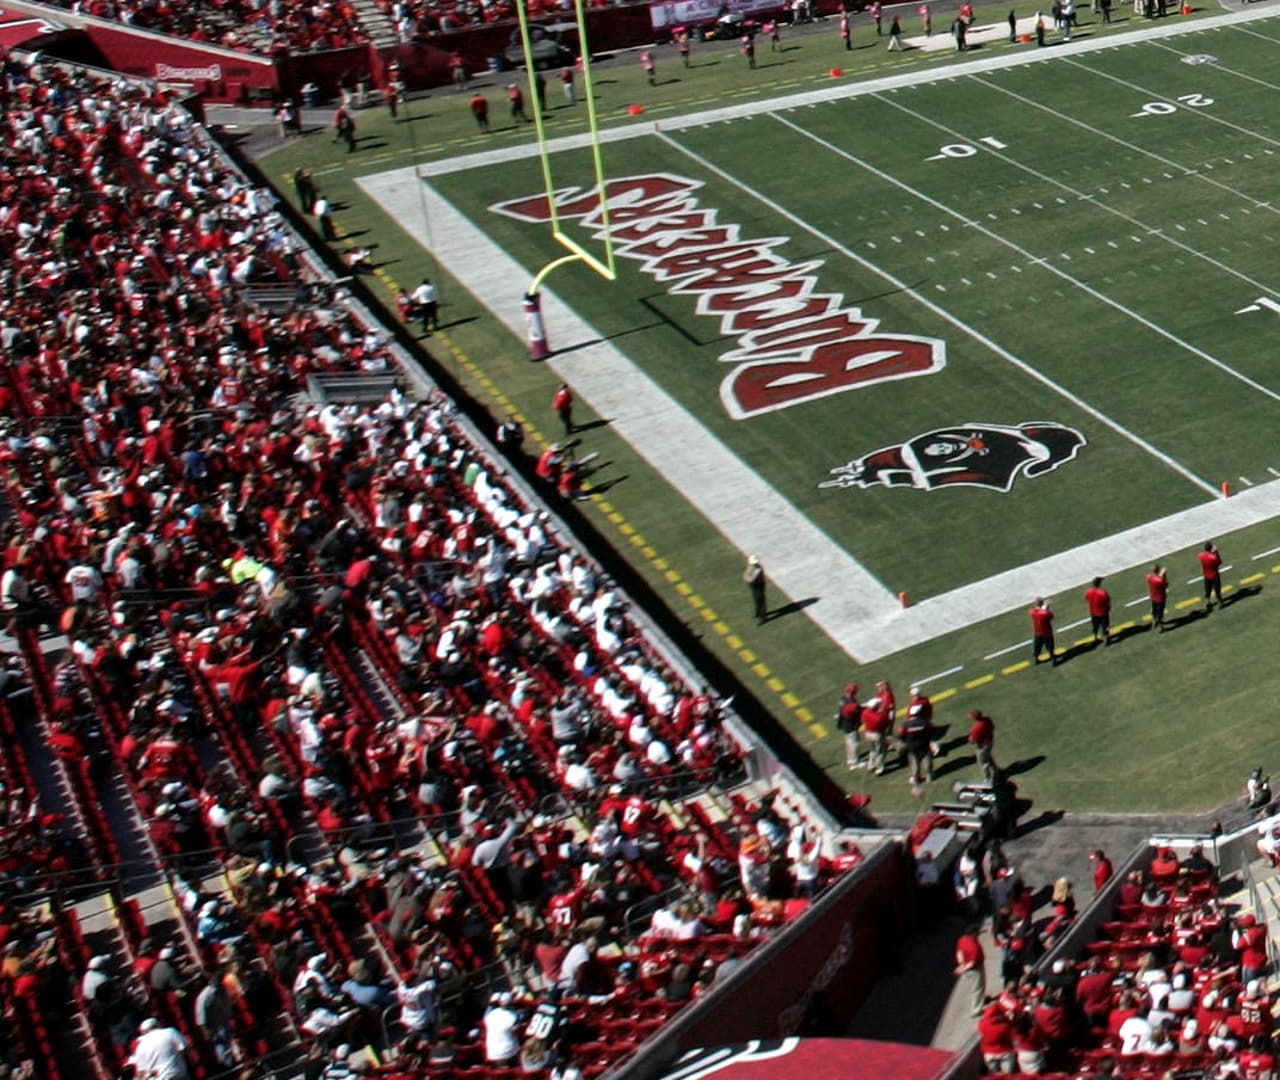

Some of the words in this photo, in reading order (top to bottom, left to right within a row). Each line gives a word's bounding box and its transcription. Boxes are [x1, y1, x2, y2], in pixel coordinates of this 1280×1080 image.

[1142, 93, 1215, 118] 20
[940, 135, 1009, 159] 10
[1131, 1034, 1143, 1052] 7
